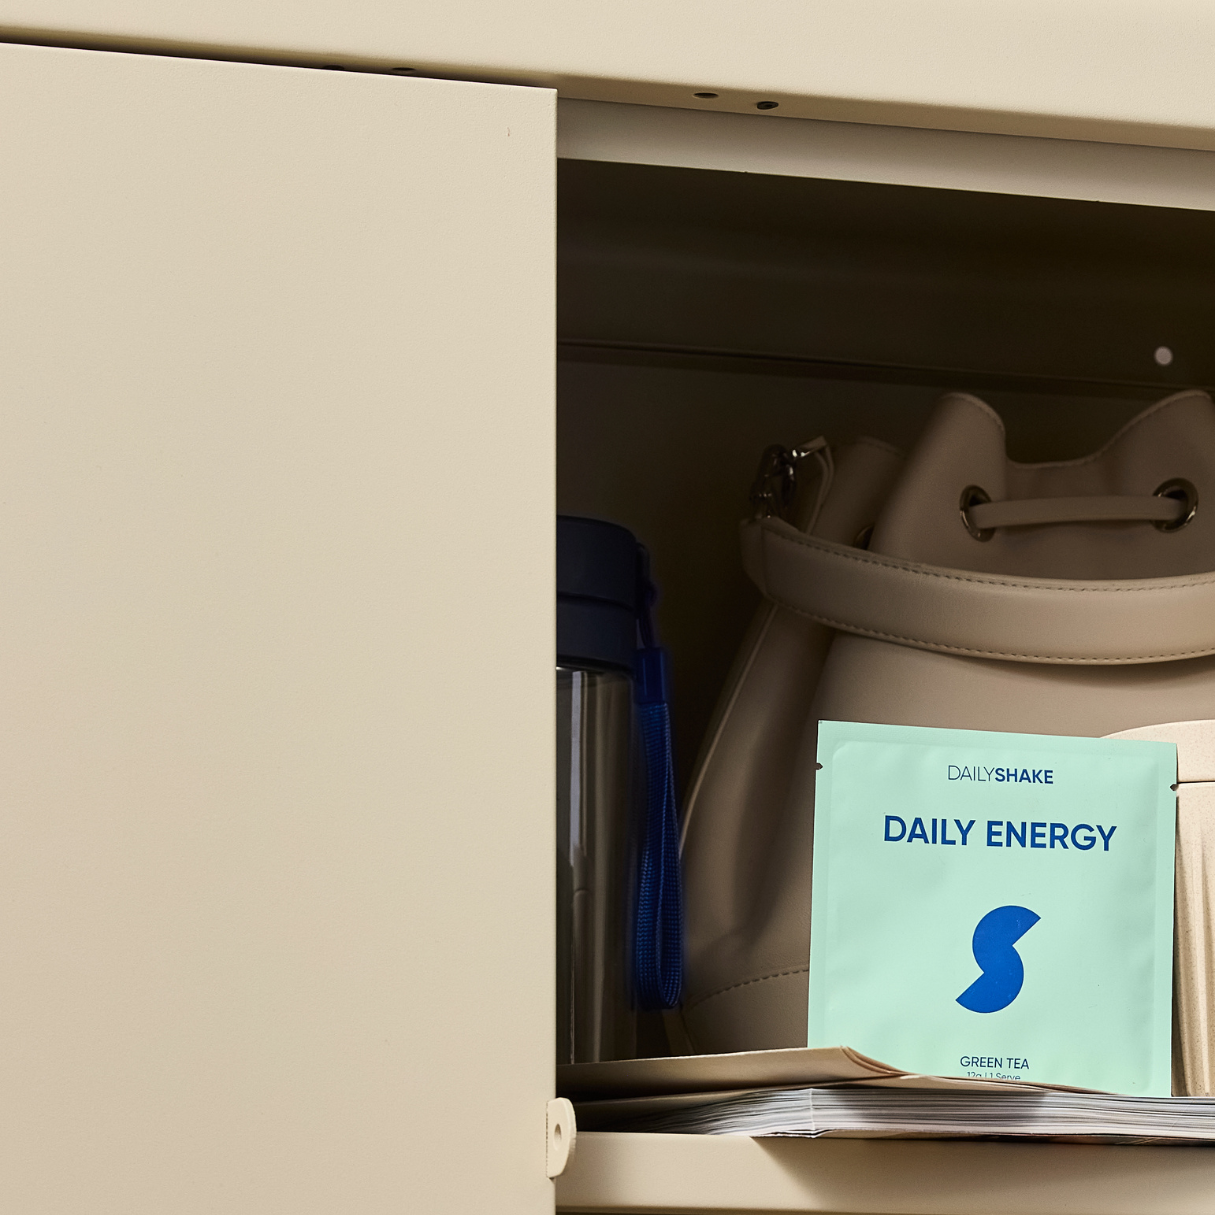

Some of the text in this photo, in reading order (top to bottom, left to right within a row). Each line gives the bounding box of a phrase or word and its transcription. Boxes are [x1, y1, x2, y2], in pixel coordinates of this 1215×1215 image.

[948, 765, 1054, 785] DAILYSHAKE
[884, 815, 1118, 852] DAILY ENERGY
[960, 1056, 1030, 1070] GREEN TEA
